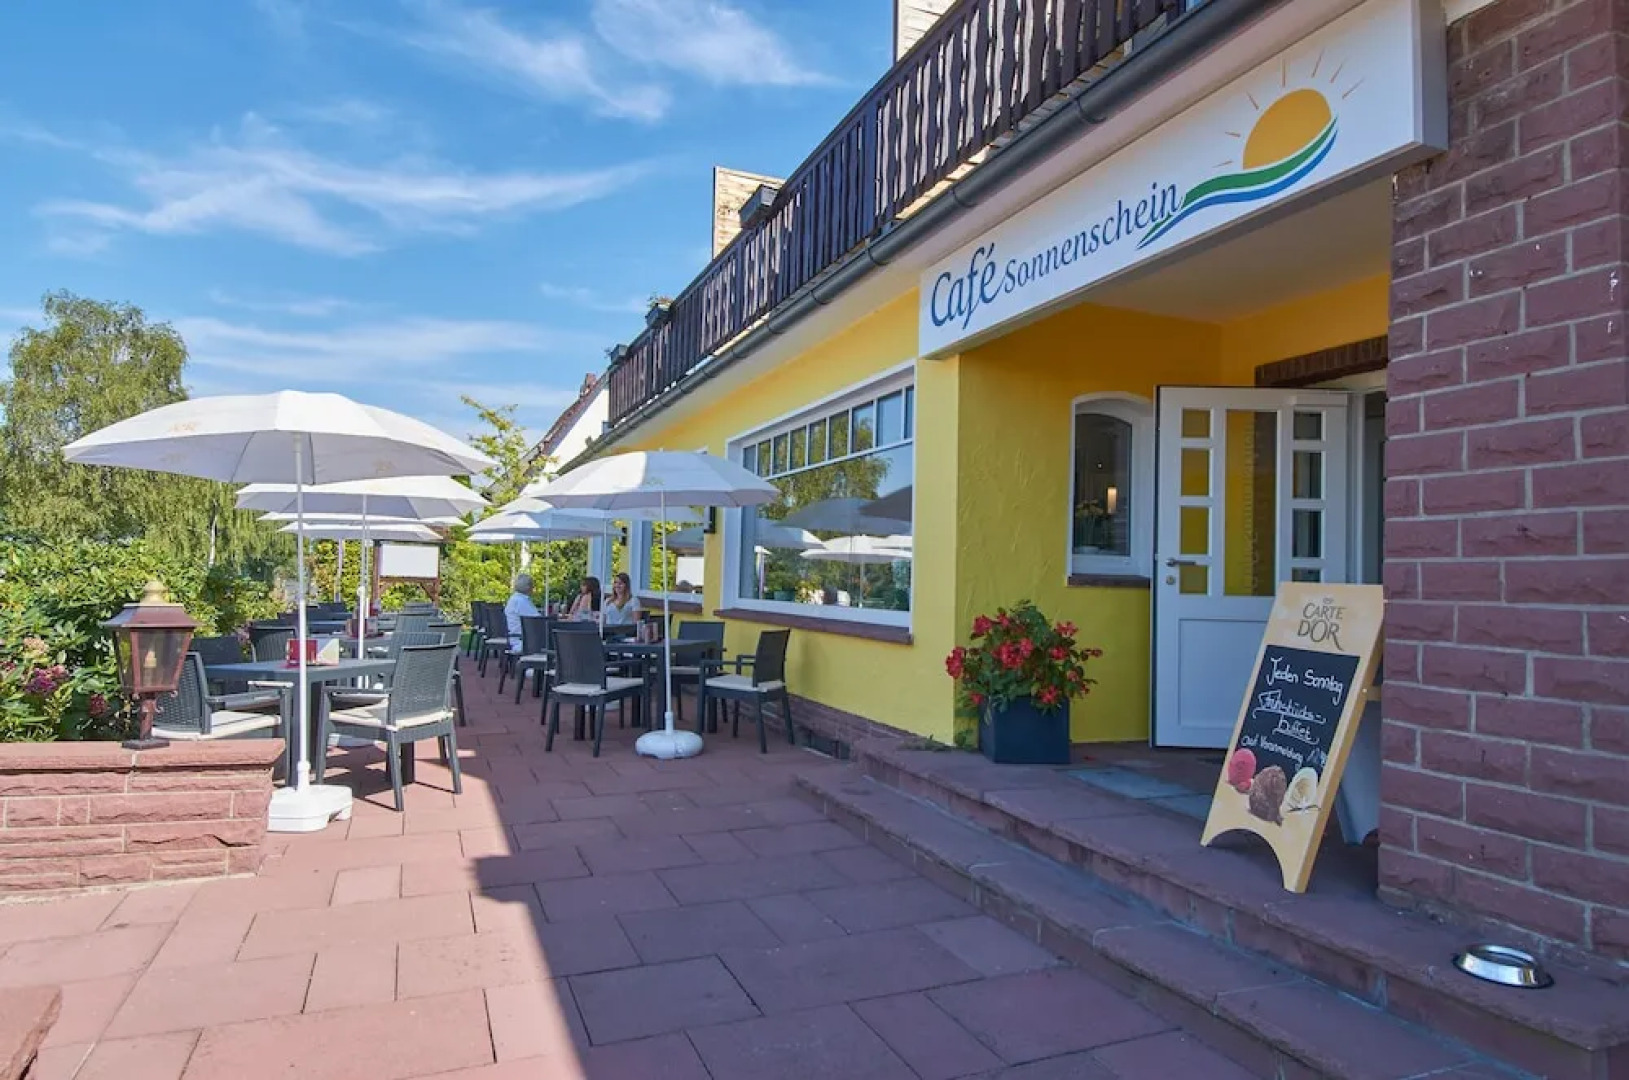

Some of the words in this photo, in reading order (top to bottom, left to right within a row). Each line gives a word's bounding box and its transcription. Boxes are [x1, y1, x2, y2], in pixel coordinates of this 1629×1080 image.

[931, 242, 1003, 330] Café
[1303, 603, 1347, 622] CARTE
[1297, 619, 1344, 651] D'OR
[1266, 657, 1299, 686] Jeden
[1303, 669, 1343, 706] Sonntag
